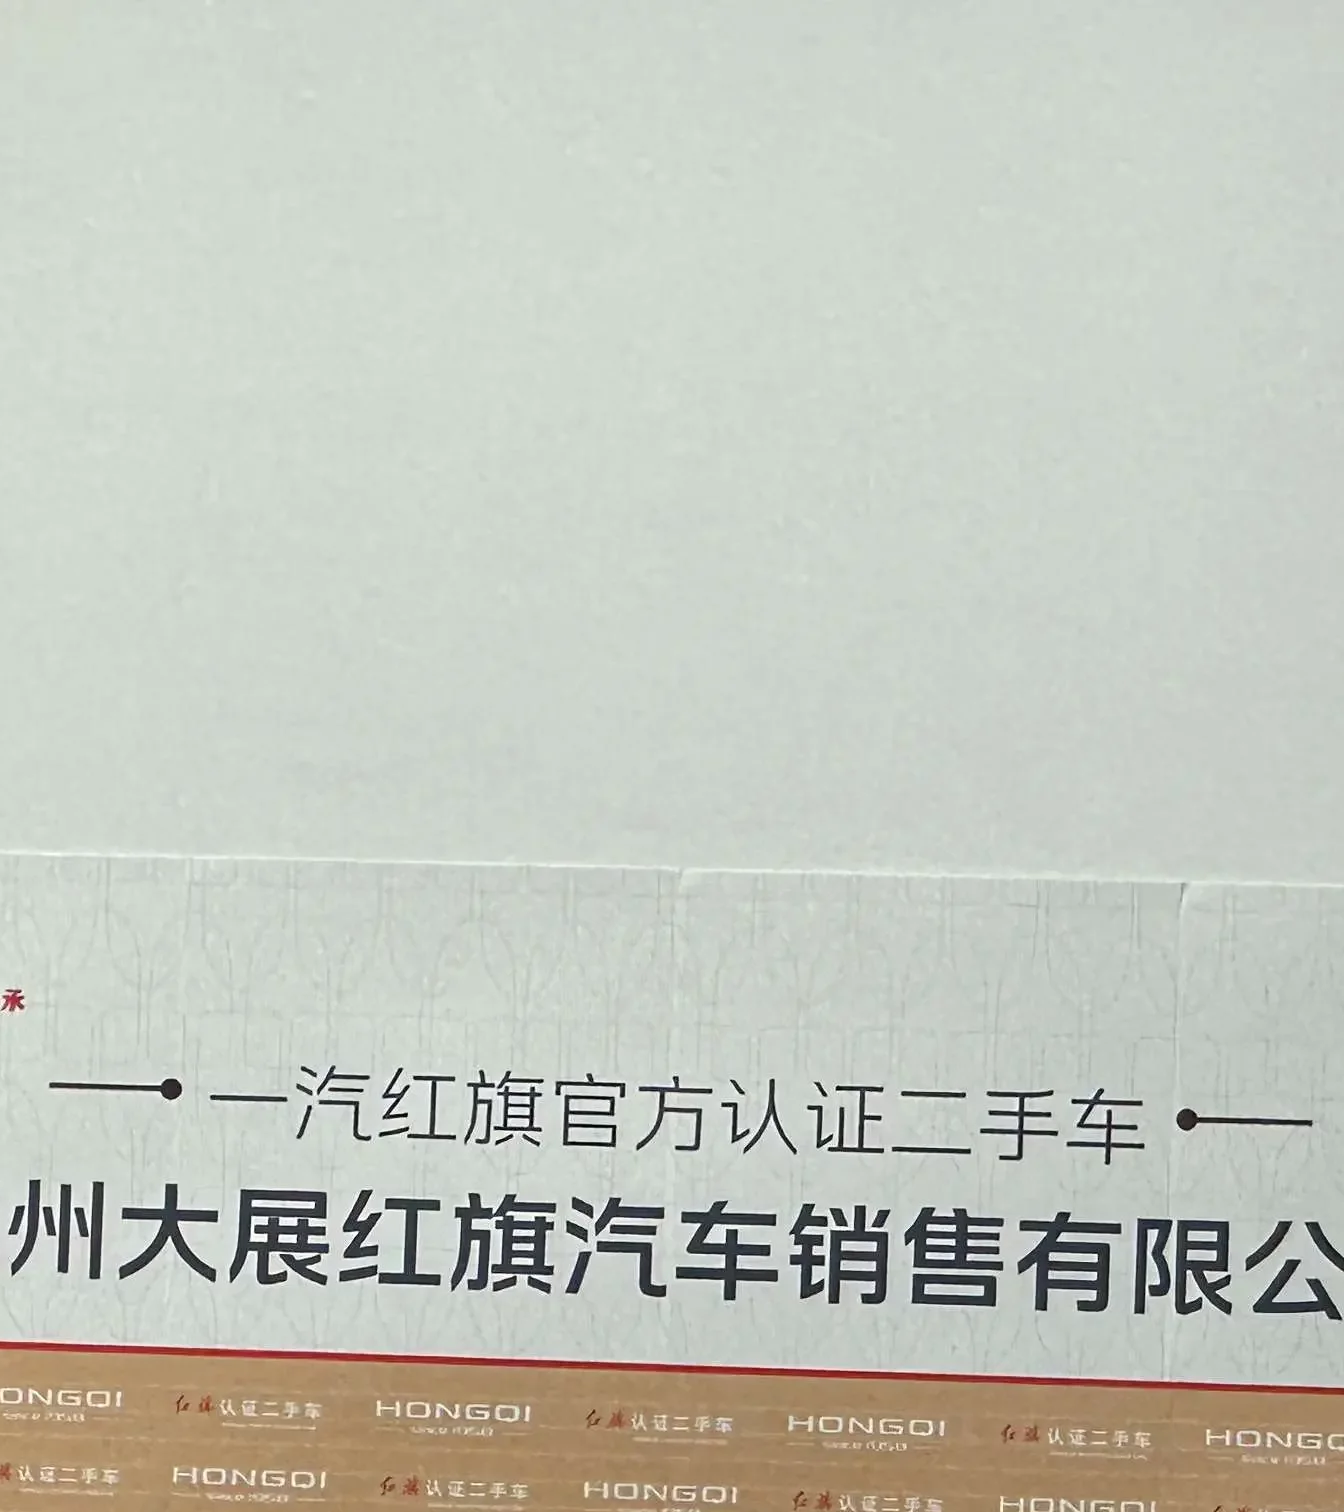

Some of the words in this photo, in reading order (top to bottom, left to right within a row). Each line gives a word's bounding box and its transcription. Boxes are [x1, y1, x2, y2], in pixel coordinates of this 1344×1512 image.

[209, 1063, 1147, 1165] 一汽红旗官方认证二手车
[376, 1400, 530, 1422] HONGQI
[788, 1415, 946, 1437] HONGQI
[172, 1467, 326, 1489] HONGQI
[584, 1481, 737, 1504] HONGQI
